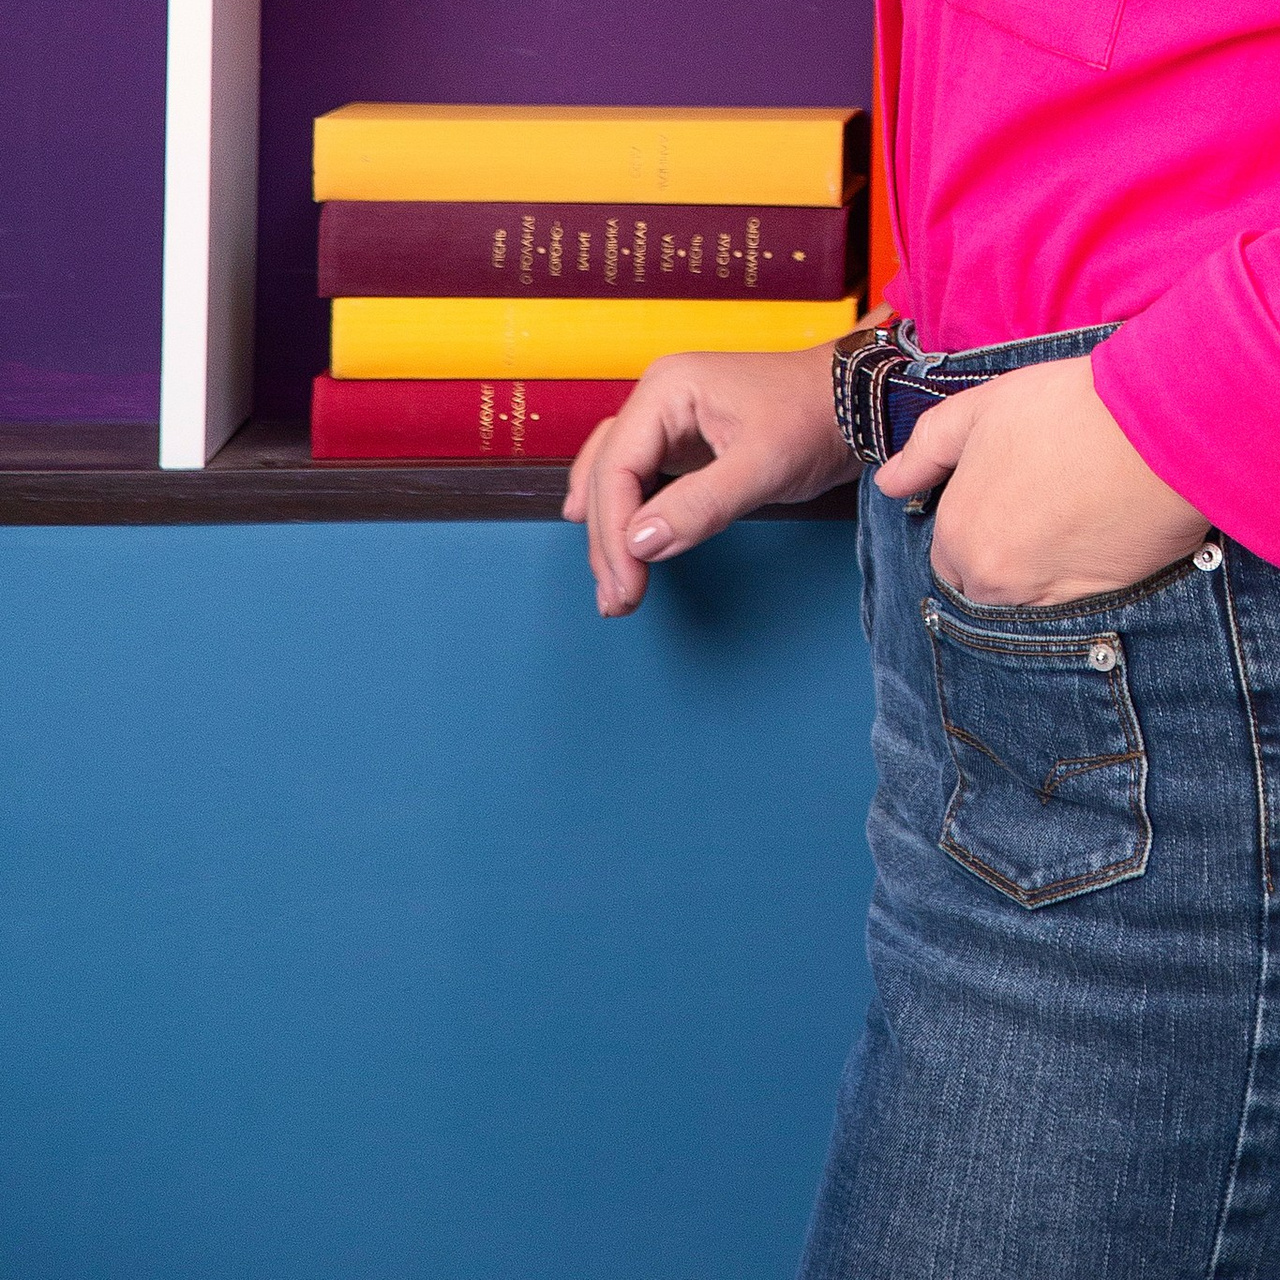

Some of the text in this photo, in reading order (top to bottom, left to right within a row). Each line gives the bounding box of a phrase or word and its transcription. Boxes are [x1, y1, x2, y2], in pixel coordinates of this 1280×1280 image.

[492, 228, 508, 268] ПЕСНЬ
[519, 215, 535, 271] РОЛАНДЕ
[688, 233, 703, 274] ПЕСНЬ
